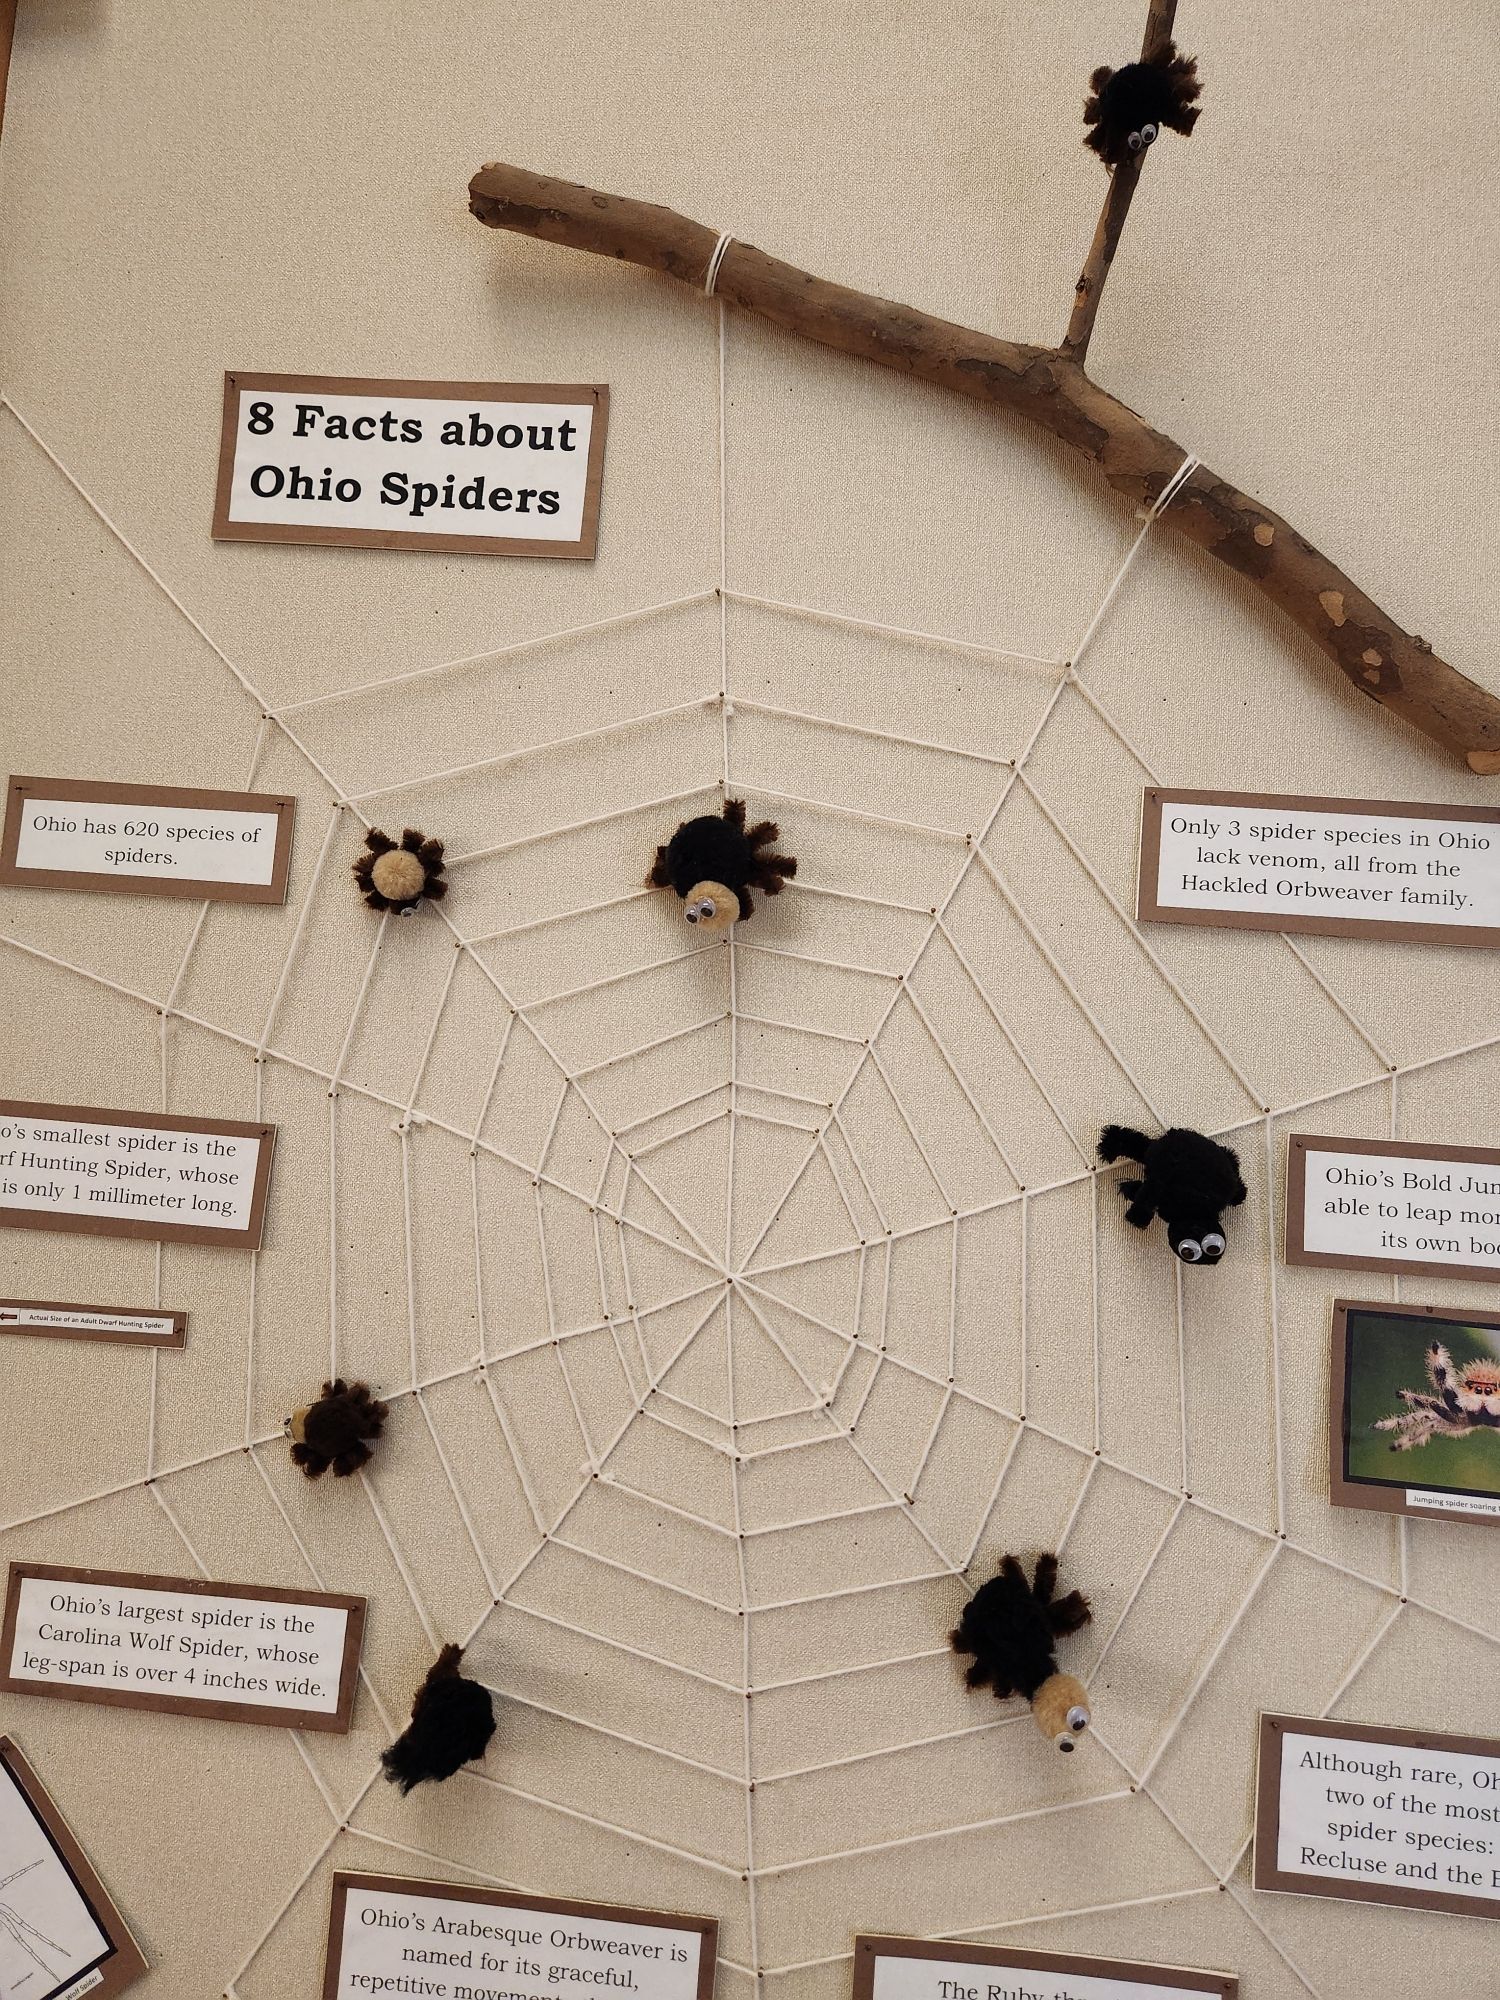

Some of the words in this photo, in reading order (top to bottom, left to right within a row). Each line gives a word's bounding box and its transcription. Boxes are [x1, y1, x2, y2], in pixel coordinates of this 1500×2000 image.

[247, 402, 274, 435] 8
[292, 404, 422, 443] Facts
[440, 412, 576, 451] about
[250, 465, 361, 502] Ohio
[380, 472, 560, 517] Spiders
[33, 816, 77, 832] Ohio
[83, 818, 116, 834] has
[124, 821, 159, 837] 620
[166, 826, 234, 842] species
[241, 828, 262, 843] of
[1171, 818, 1221, 839] Only
[1228, 820, 1240, 836] 3
[1249, 823, 1316, 842] spider
[1324, 828, 1401, 846] species
[1409, 830, 1430, 847] in
[1439, 832, 1490, 850] Ohio
[105, 847, 177, 865] spiders.
[1197, 847, 1241, 864] lack
[1248, 854, 1325, 872] venom,
[1334, 855, 1359, 871] all
[1368, 856, 1418, 874] from
[1426, 860, 1460, 877] the
[1182, 875, 1268, 895] Hackled
[1276, 880, 1393, 901] Orbweaver
[1400, 887, 1473, 910] family.
[1, 1123, 25, 1139] o's
[33, 1128, 110, 1146] smallest
[118, 1134, 177, 1152] spider
[183, 1139, 198, 1154] is
[206, 1140, 236, 1157] the
[20, 1152, 99, 1177] Hunting
[105, 1160, 170, 1182] Spider,
[179, 1166, 239, 1185] whose
[1326, 1168, 1394, 1187] Ohio's
[1403, 1173, 1452, 1192] Bold
[2, 1179, 17, 1194] is
[24, 1182, 65, 1202] only
[73, 1184, 80, 1199] 1
[88, 1187, 186, 1208] millimeter
[191, 1194, 236, 1217] long.
[1325, 1197, 1369, 1215] able
[1378, 1202, 1398, 1218] to
[1406, 1202, 1451, 1226] leap
[1381, 1230, 1407, 1248] its
[1416, 1238, 1461, 1252] own
[1413, 1495, 1444, 1506] Jumping
[1469, 1503, 1497, 1512] soaring
[50, 1595, 110, 1616] Ohio's
[117, 1600, 184, 1624] largest
[191, 1609, 253, 1629] spider
[259, 1612, 275, 1630] is
[284, 1615, 314, 1633] the
[39, 1624, 121, 1647] Carolina
[129, 1632, 175, 1651] Wolf
[179, 1637, 248, 1662] Spider,
[257, 1644, 319, 1665] whose
[22, 1651, 105, 1677] leg-span
[112, 1660, 128, 1678] is
[136, 1667, 178, 1682] over
[184, 1668, 196, 1684] 4
[203, 1669, 268, 1691] inches
[275, 1678, 325, 1697] wide.
[1299, 1751, 1402, 1782] Although
[1411, 1768, 1463, 1789] rare,
[1326, 1787, 1364, 1806] two
[1373, 1792, 1396, 1810] of
[1401, 1795, 1436, 1815] the
[1445, 1804, 1500, 1823] most
[1328, 1820, 1397, 1842] spider
[1405, 1832, 1493, 1854] species:
[1301, 1847, 1387, 1873] Recluse
[1395, 1862, 1437, 1880] and
[1447, 1865, 1482, 1886] the
[361, 1908, 425, 1931] Ohio's
[432, 1916, 542, 1947] Arabesque
[550, 1930, 663, 1959] Orbweaver
[670, 1943, 687, 1962] is
[350, 1974, 446, 1996] repetitive
[402, 1949, 472, 1968] named
[480, 1956, 509, 1972] for
[515, 1959, 541, 1976] its
[548, 1966, 638, 1992] graceful,
[64, 1988, 80, 2000] Wolf
[80, 1976, 97, 1991] Spider
[938, 1981, 978, 2000] The
